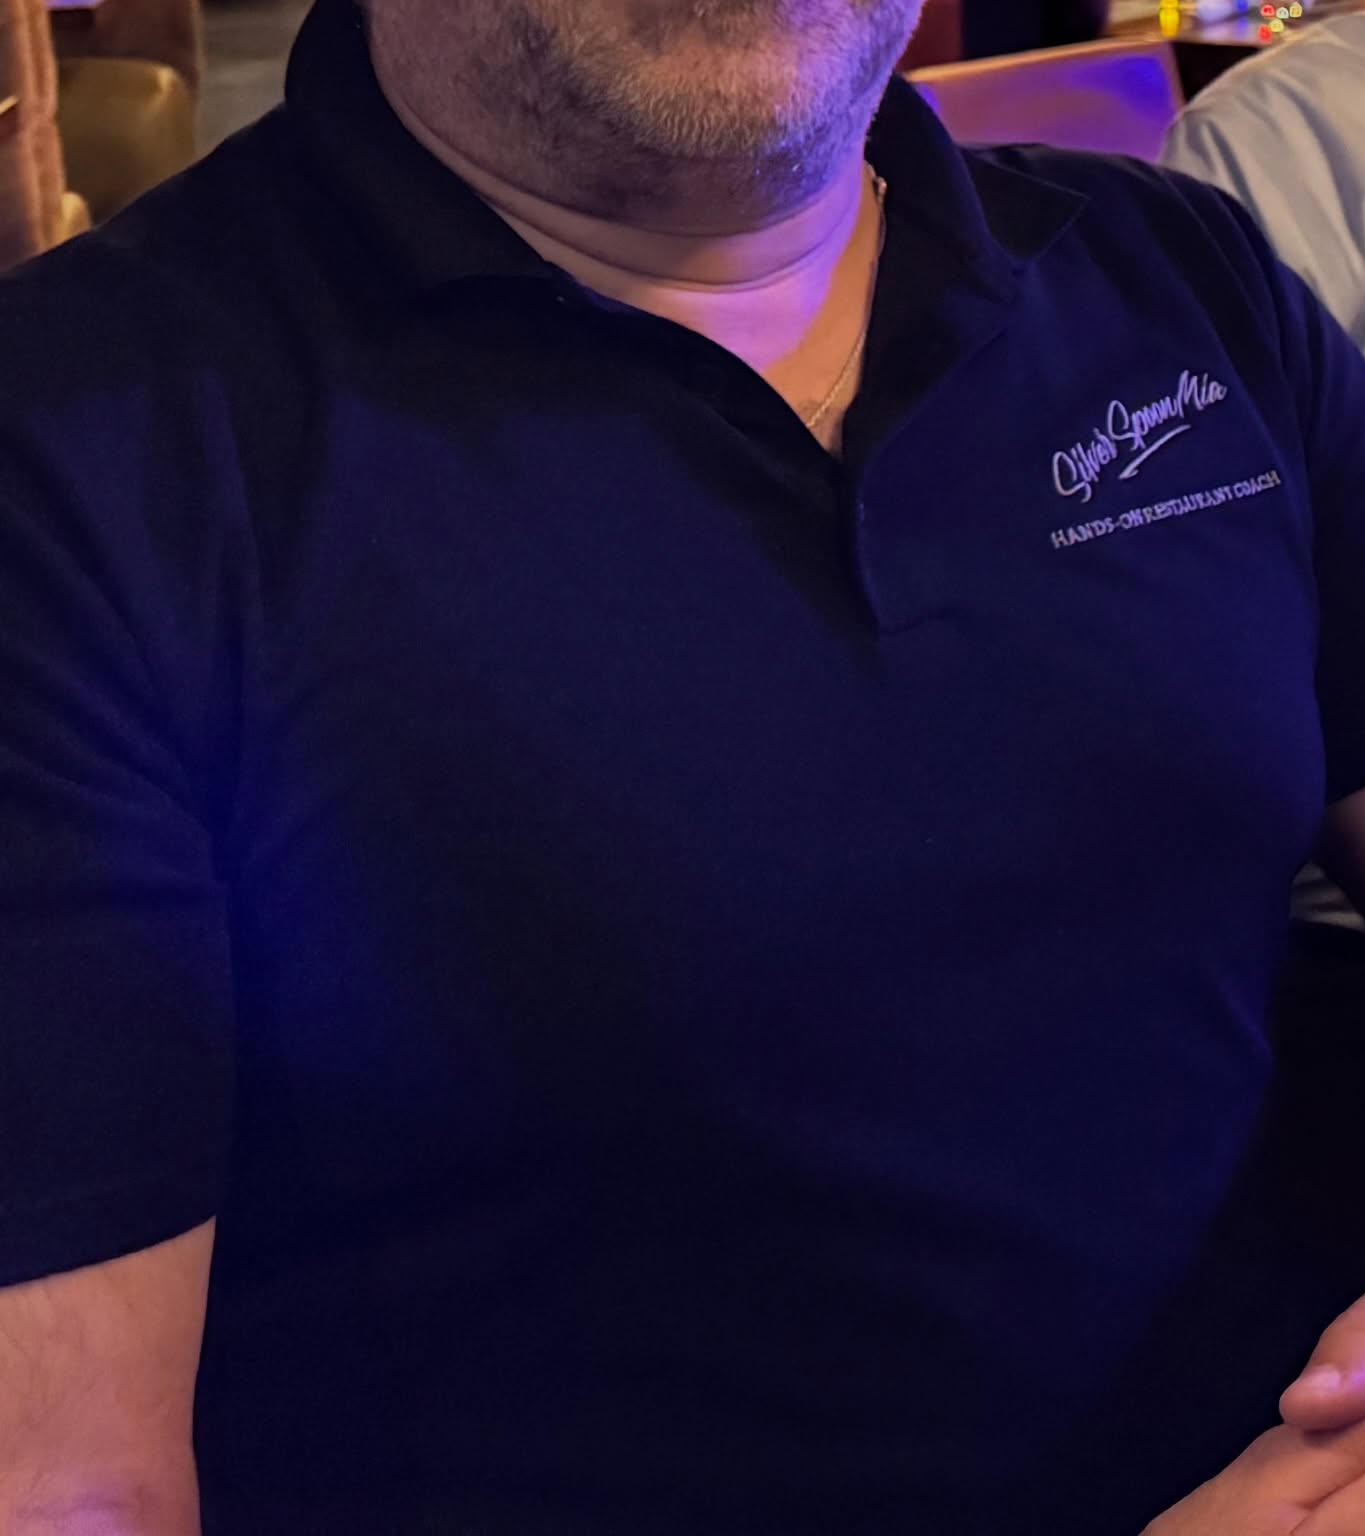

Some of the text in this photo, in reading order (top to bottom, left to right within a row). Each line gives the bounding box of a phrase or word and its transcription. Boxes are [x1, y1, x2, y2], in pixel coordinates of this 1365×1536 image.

[1051, 469, 1281, 549] HANDS-ON RESTAURANT COACH
